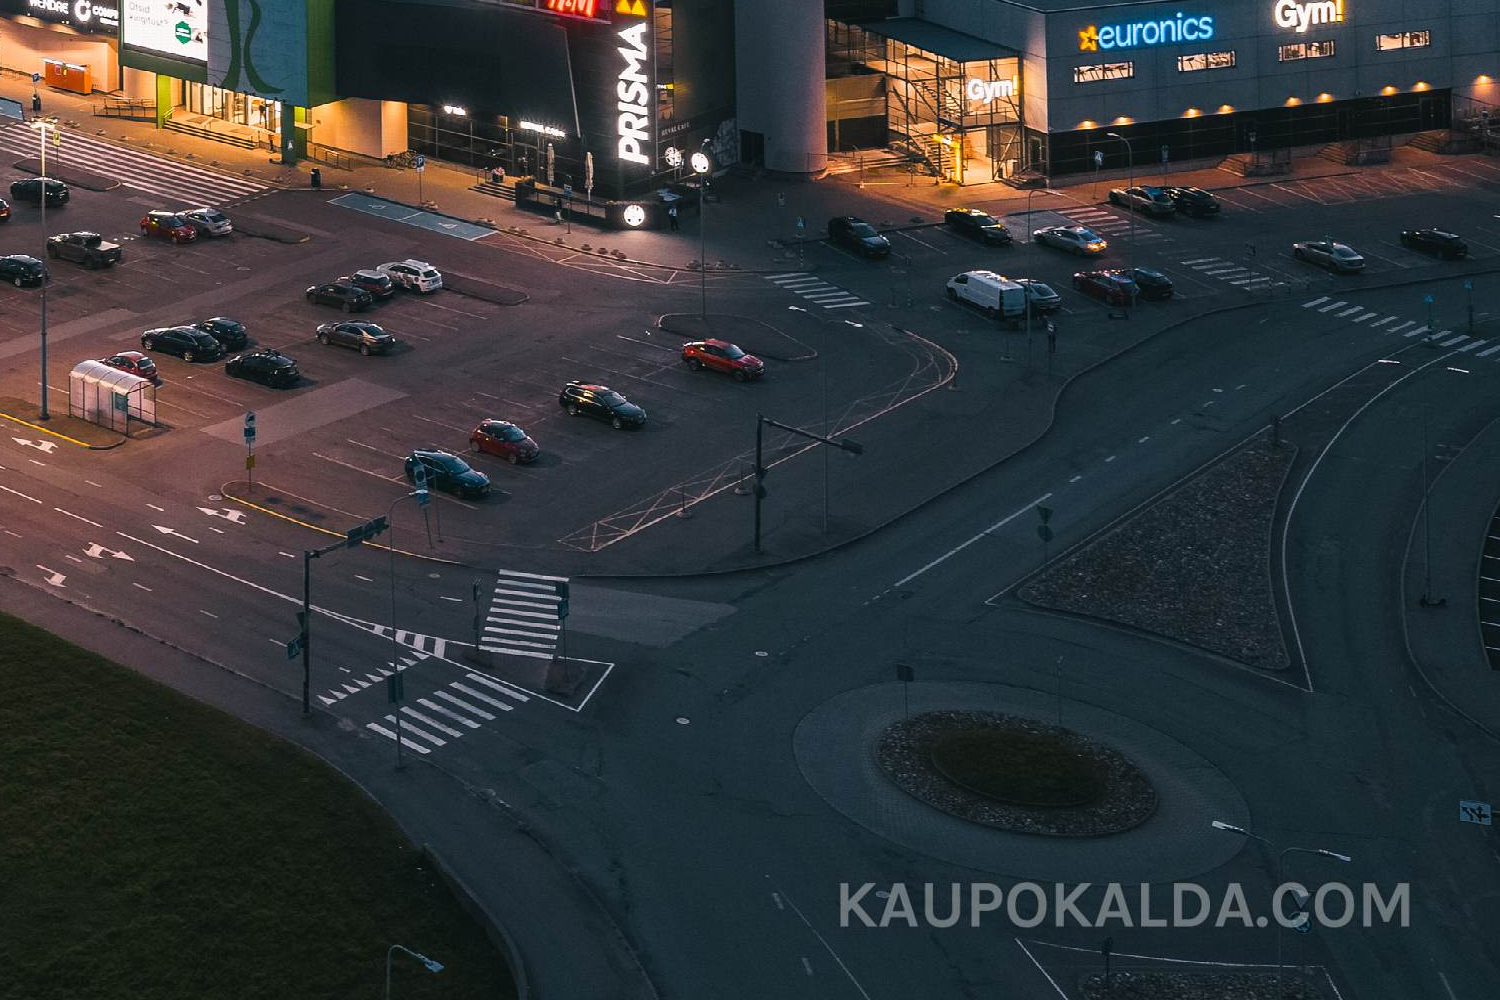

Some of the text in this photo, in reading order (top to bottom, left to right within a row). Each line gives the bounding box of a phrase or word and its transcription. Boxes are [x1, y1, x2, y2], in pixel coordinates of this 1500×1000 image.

[1099, 12, 1214, 50] euronics
[616, 21, 650, 166] PRISMA
[967, 75, 1019, 104] Gym!
